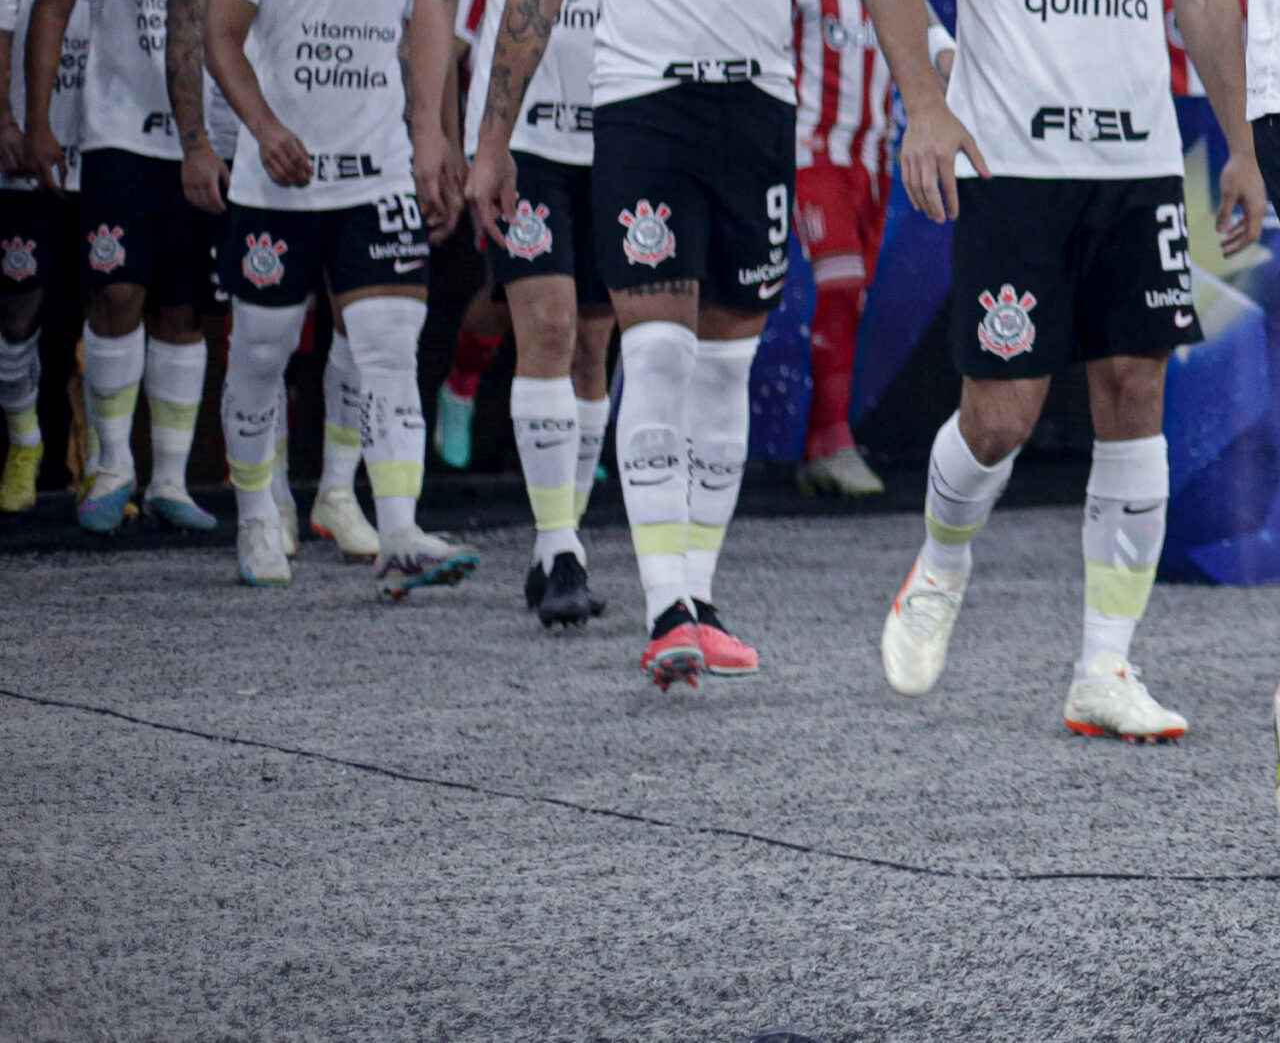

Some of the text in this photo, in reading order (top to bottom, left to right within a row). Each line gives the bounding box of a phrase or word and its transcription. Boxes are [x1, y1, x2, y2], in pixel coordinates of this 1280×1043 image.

[296, 41, 354, 63] neo
[1031, 107, 1150, 143] FIEL
[766, 183, 788, 245] 9
